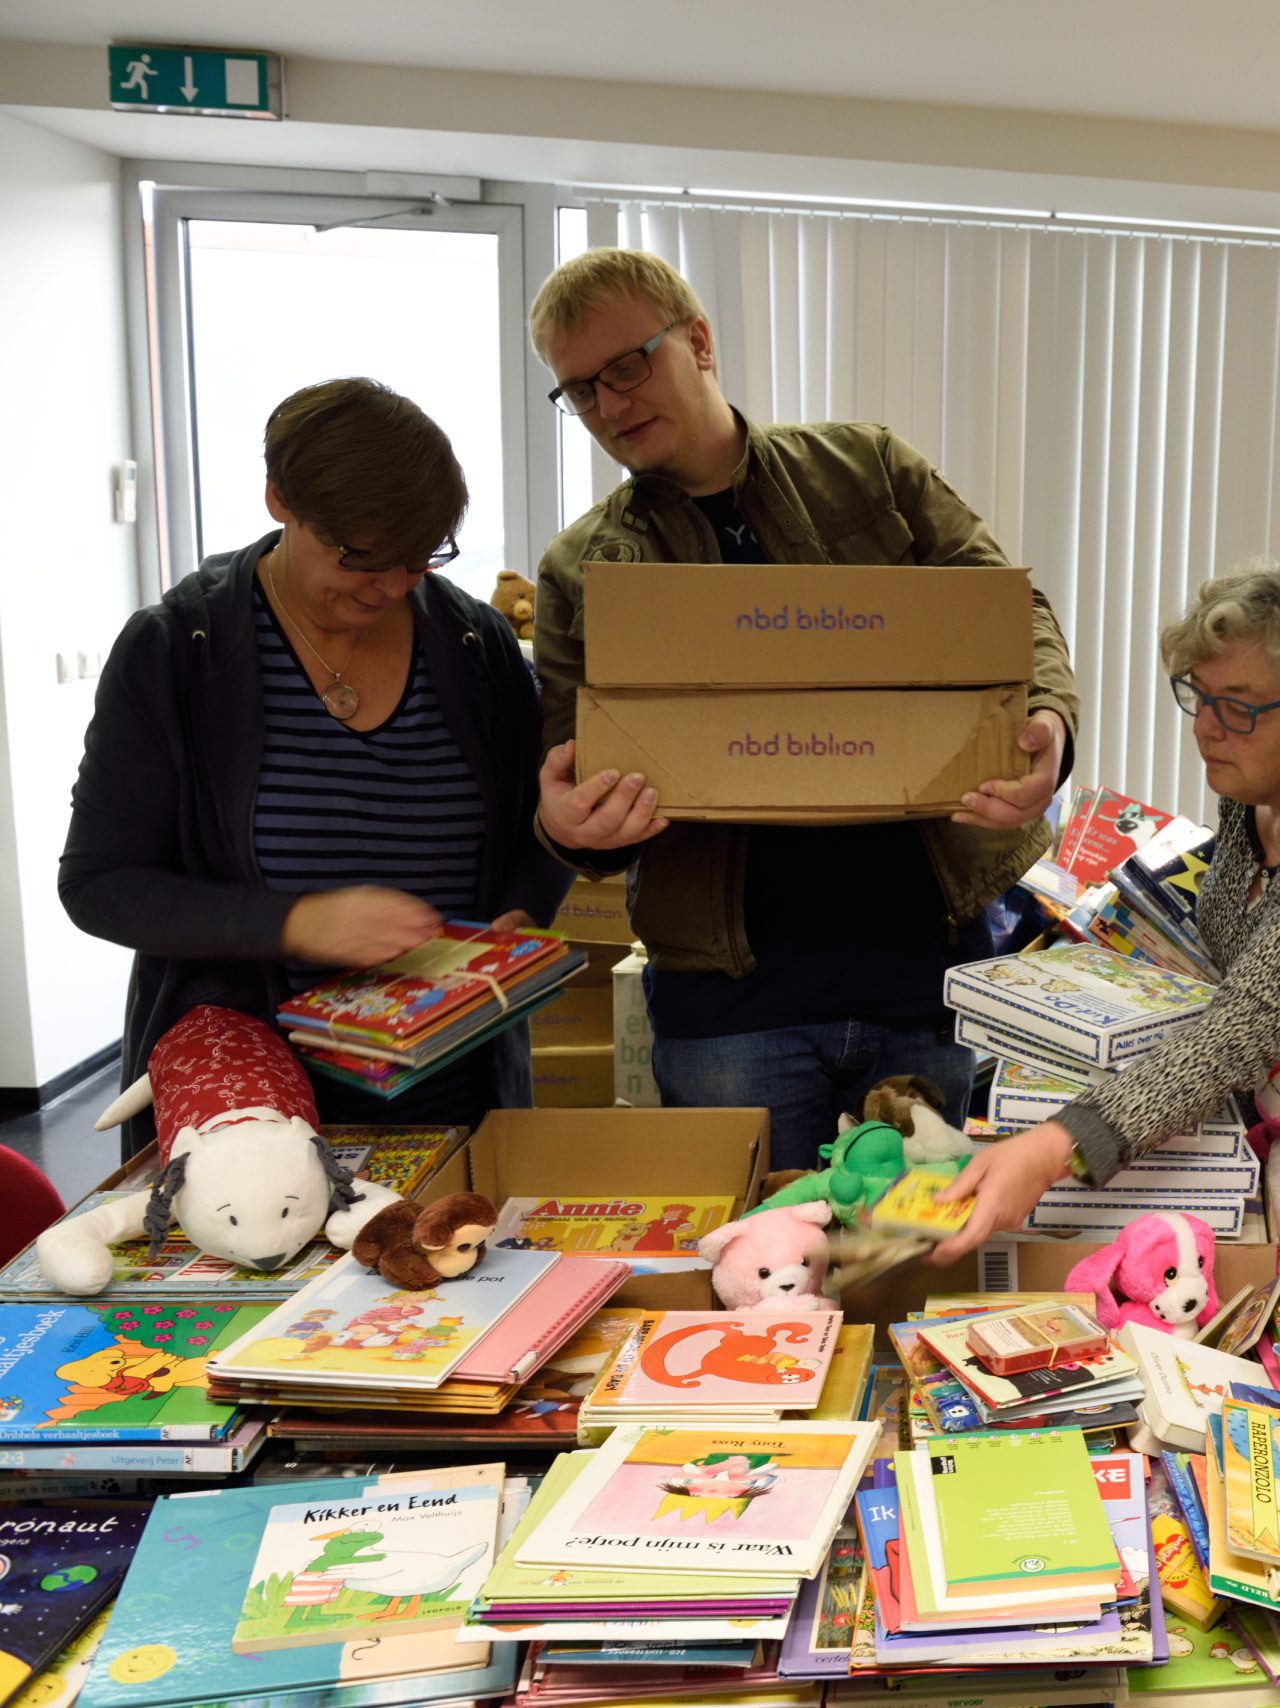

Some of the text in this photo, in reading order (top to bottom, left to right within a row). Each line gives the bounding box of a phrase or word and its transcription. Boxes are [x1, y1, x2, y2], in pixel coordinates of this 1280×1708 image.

[736, 604, 886, 632] nbd biblion
[727, 731, 876, 757] nbd biblion
[1114, 1038, 1135, 1051] Alles
[528, 1200, 646, 1218] Annie
[477, 1274, 505, 1285] pot
[710, 1437, 787, 1451] Tony Ross
[111, 1454, 154, 1469] Uitgeverij
[156, 1454, 180, 1466] Peter
[1251, 1421, 1272, 1505] RAPERONZOLO
[304, 1493, 459, 1525] Kikker en Eend
[392, 1513, 416, 1523] Max
[868, 1505, 897, 1523] Ik
[0, 1515, 119, 1535] ronaut
[564, 1533, 795, 1557] Waar is mijn potje?
[1241, 1584, 1271, 1600] RELD
[947, 1697, 985, 1708] vervoer
